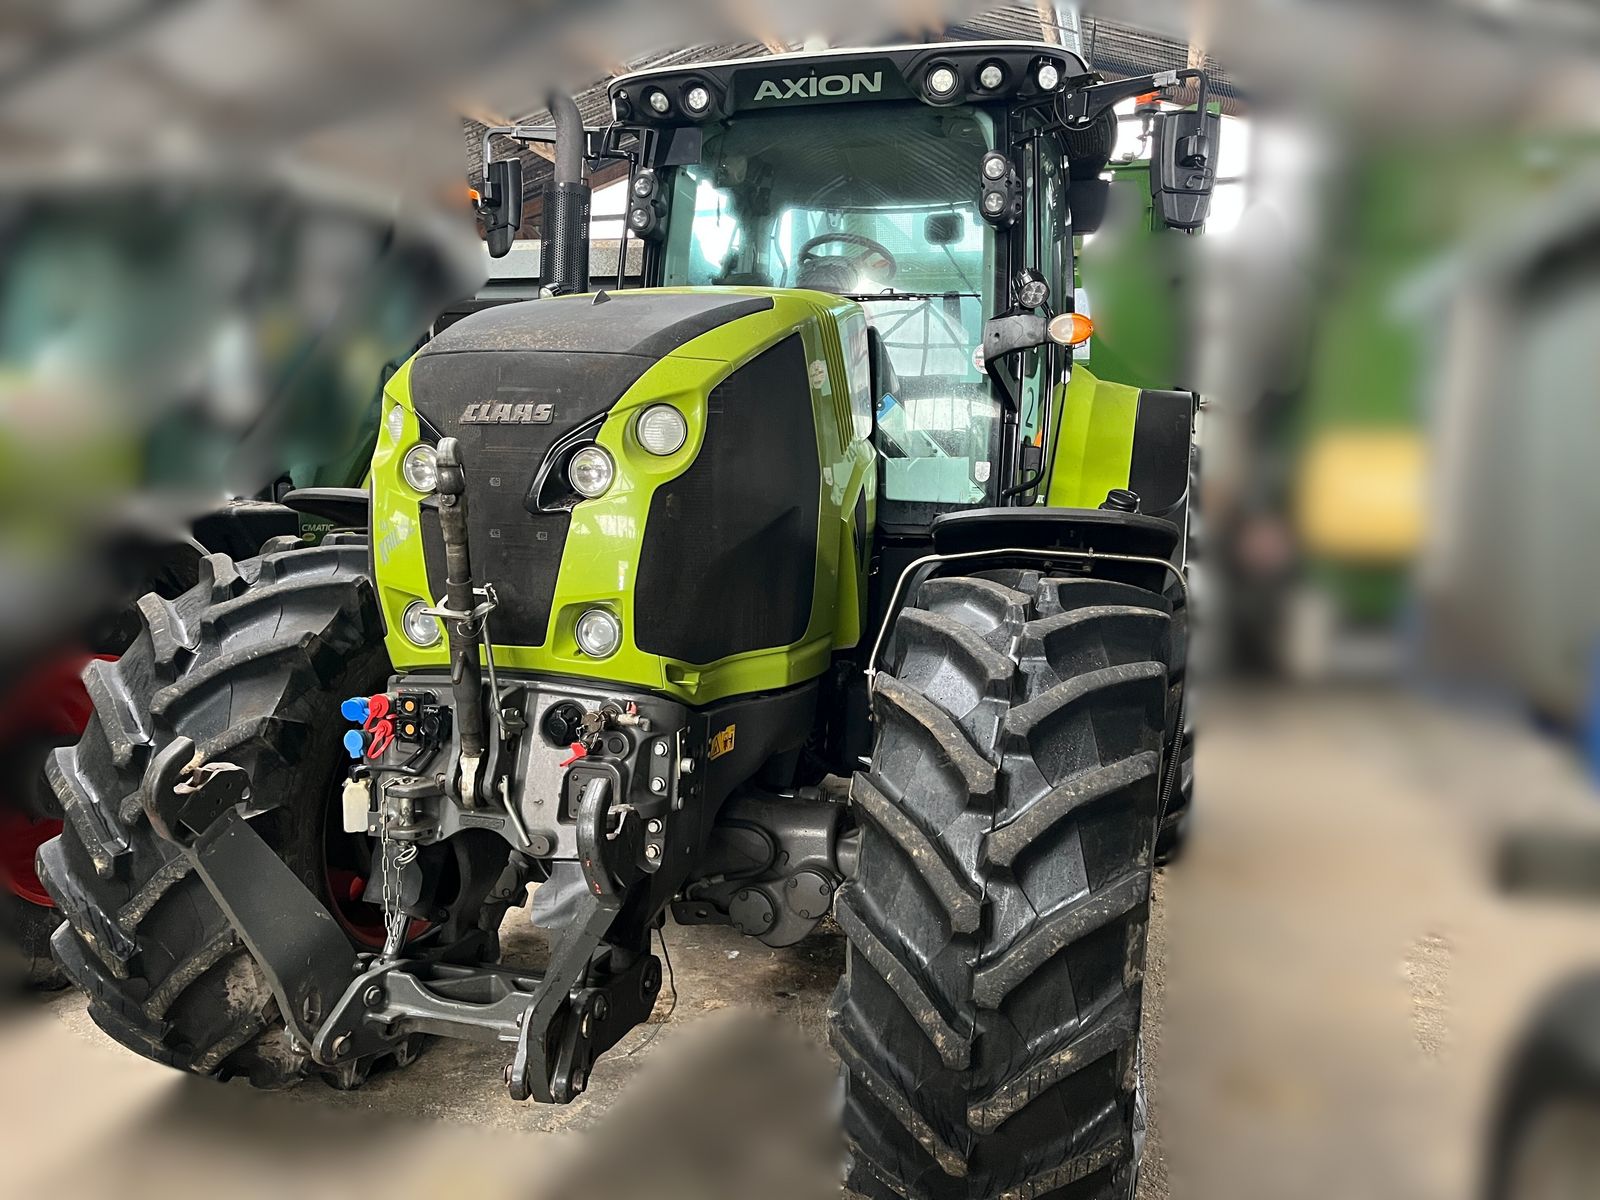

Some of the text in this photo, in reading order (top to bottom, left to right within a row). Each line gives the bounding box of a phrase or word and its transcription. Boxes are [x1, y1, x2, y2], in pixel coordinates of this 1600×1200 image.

[753, 71, 882, 100] AXION
[460, 403, 555, 424] CLAAS
[301, 523, 335, 531] CMATIC
